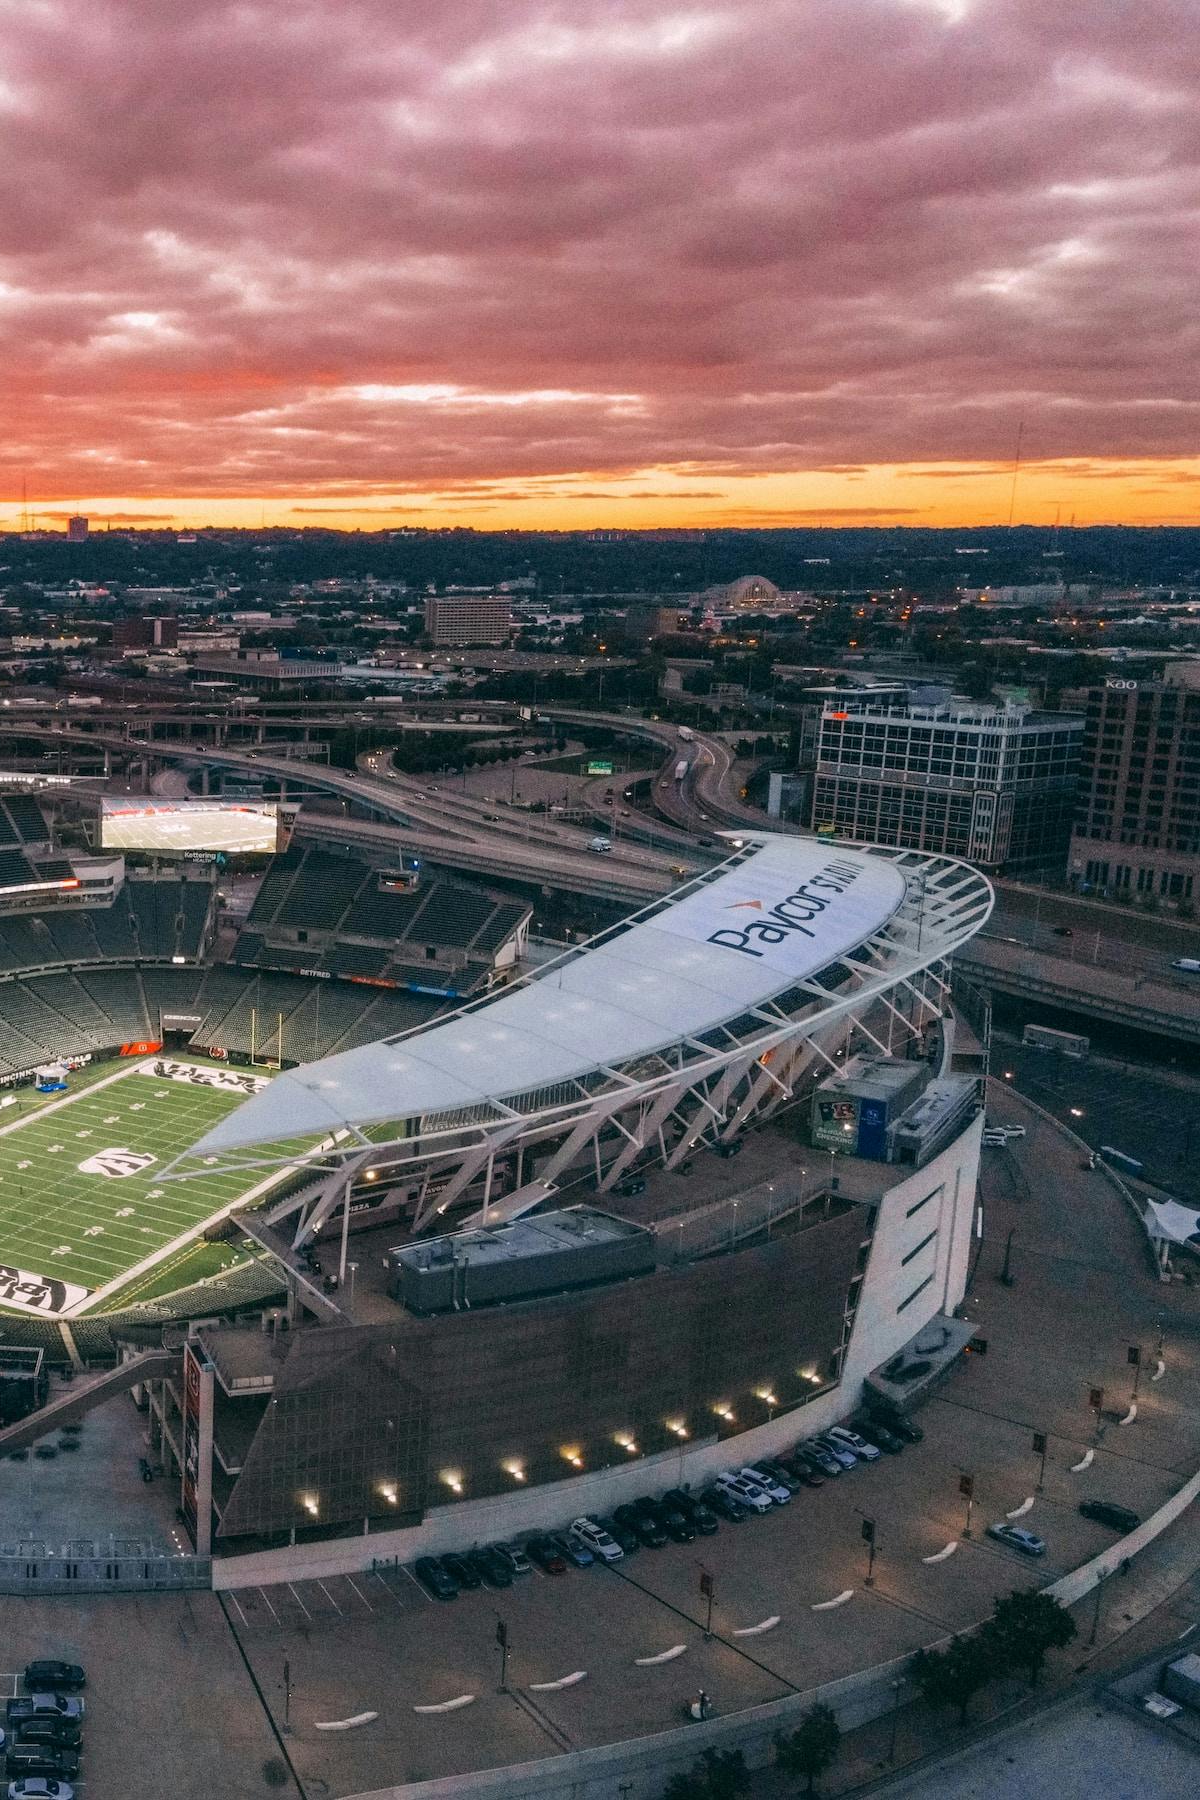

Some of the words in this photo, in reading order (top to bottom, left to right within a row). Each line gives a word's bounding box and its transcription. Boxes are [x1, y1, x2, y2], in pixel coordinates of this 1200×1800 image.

[184, 851, 217, 861] Kettering
[706, 885, 832, 957] Paycor
[163, 1014, 201, 1022] GEICO
